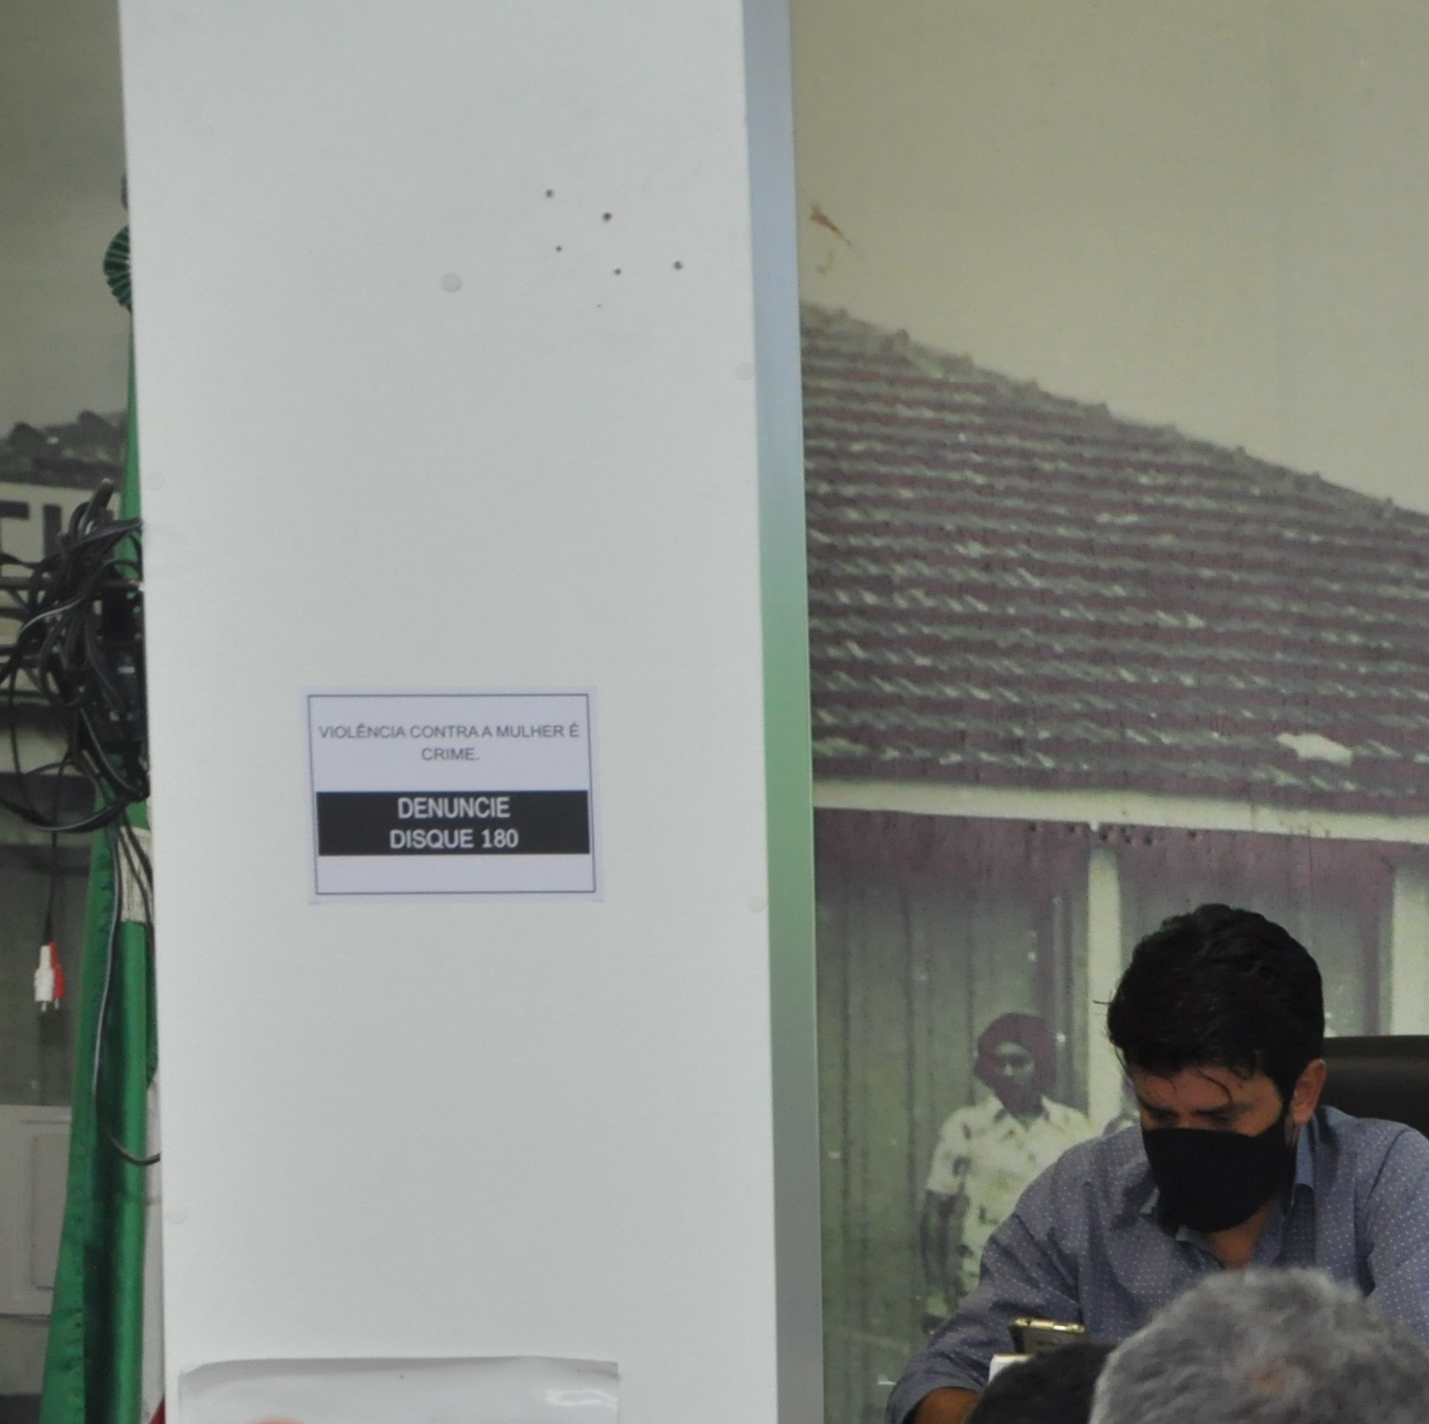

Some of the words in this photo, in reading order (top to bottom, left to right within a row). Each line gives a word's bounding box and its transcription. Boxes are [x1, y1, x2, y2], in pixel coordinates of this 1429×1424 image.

[318, 723, 405, 739] VIOLÊNCIA
[409, 725, 477, 738] CONTRA
[481, 725, 493, 738] A
[496, 724, 565, 738] MULHER
[570, 722, 580, 737] É
[421, 747, 480, 761] CRIME.
[397, 797, 511, 819] DENUNCIE
[389, 829, 474, 849] DISQUE
[481, 829, 519, 848] 180
